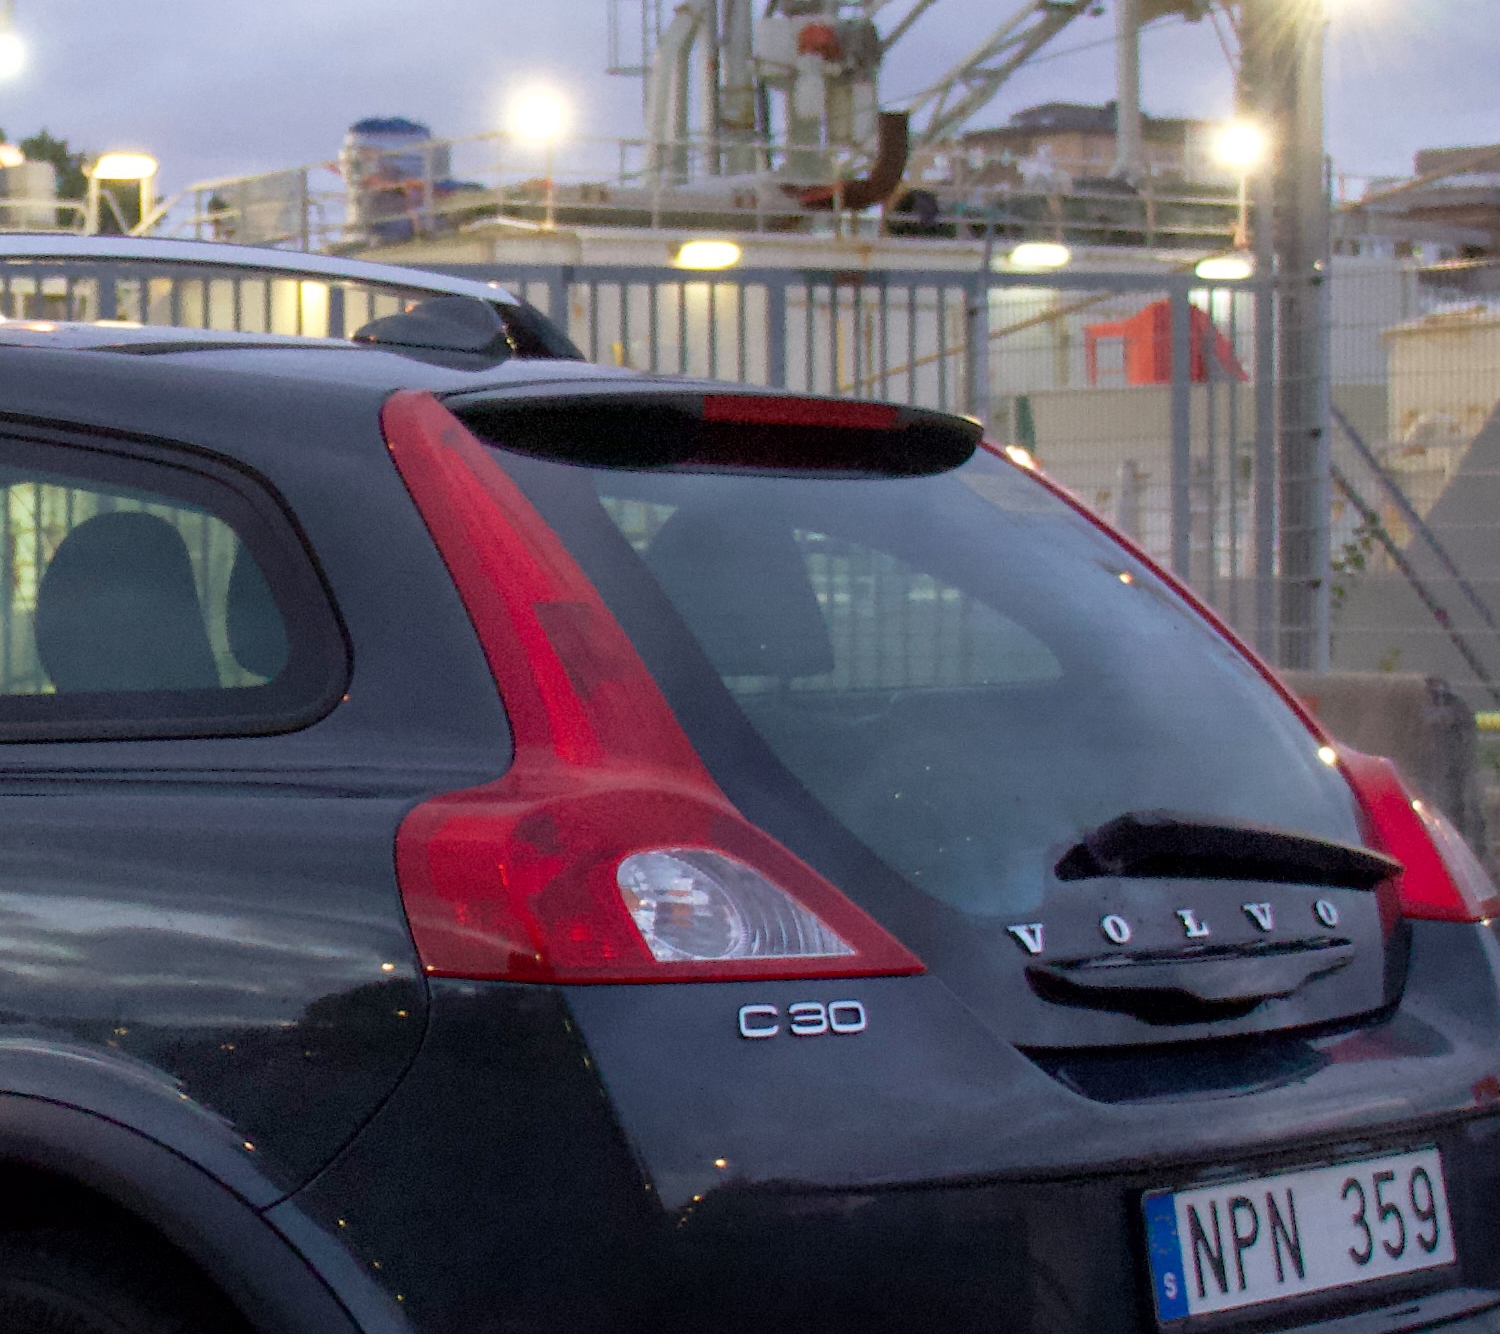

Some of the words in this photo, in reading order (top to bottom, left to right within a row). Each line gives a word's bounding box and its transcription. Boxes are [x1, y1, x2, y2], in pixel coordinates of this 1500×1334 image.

[1006, 898, 1339, 954] VOLVO
[738, 1000, 867, 1038] C30
[1186, 1188, 1305, 1298] NPN
[1341, 1166, 1440, 1266] 359
[1162, 1271, 1179, 1300] S
